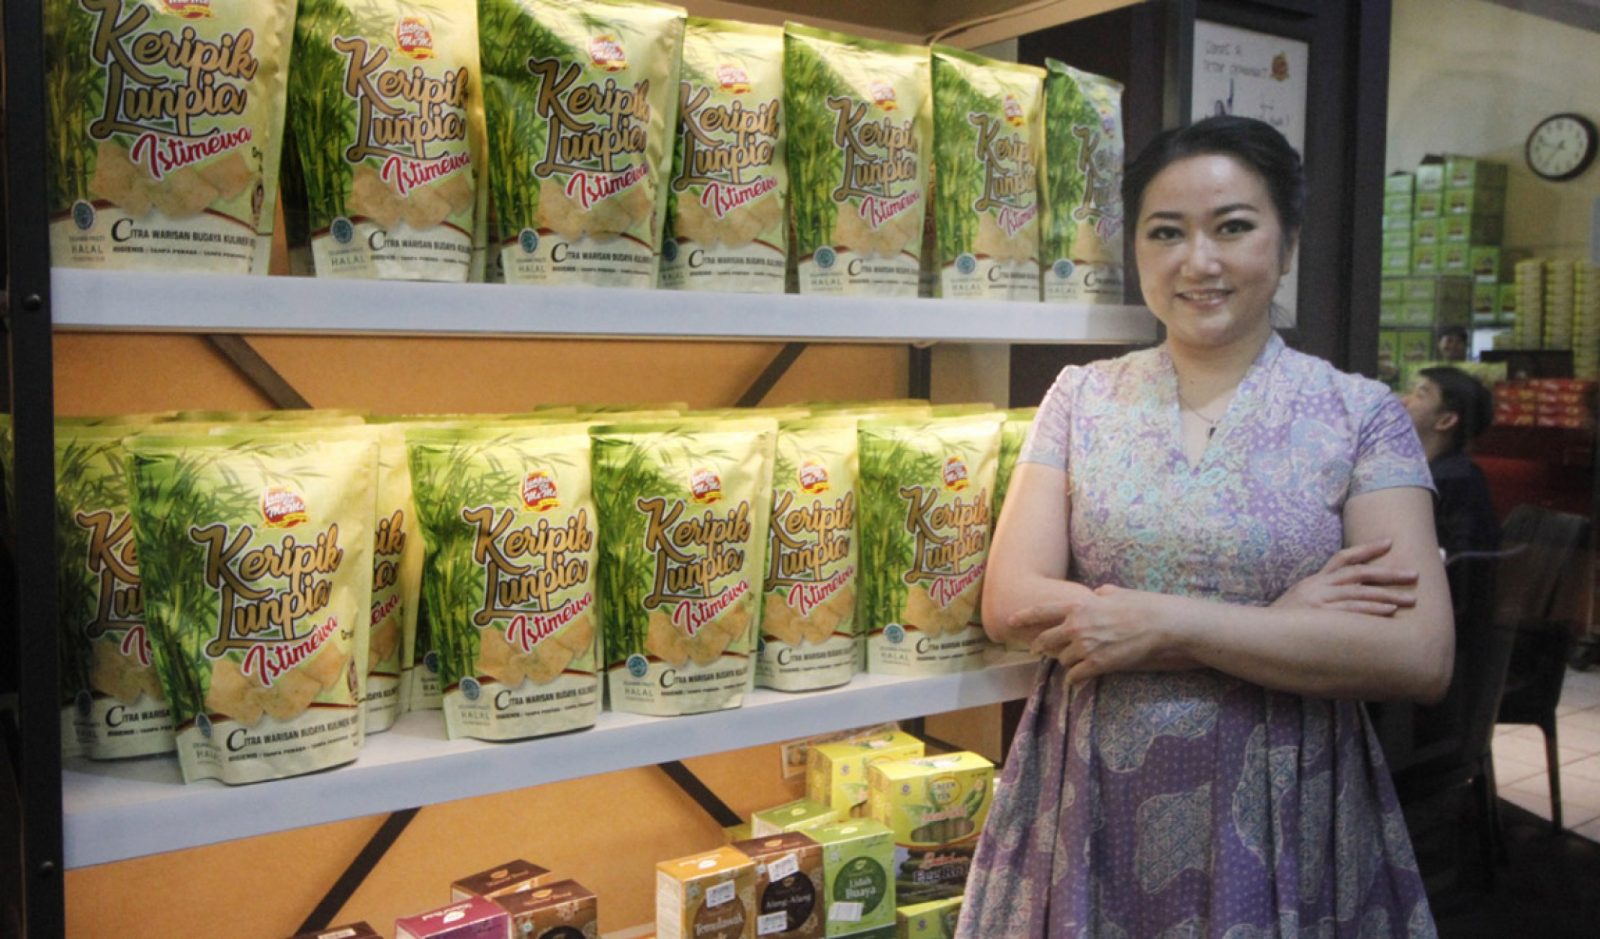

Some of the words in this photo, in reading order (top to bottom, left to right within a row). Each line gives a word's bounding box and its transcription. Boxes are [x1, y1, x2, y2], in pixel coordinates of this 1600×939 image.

[82, 0, 258, 88] Keripik
[89, 62, 247, 139] Lunpia
[346, 94, 466, 162] Lunpia
[131, 127, 252, 180] Istimewa
[382, 152, 471, 196] Istimewa
[672, 130, 775, 192] Lunpia
[566, 163, 648, 210] Istimewa
[702, 176, 778, 218] Istimewa
[462, 507, 593, 574] Keripik
[637, 498, 751, 560] Keripik
[900, 486, 988, 542] Keripik
[190, 523, 344, 597] Keripik
[643, 545, 744, 610] Lunpia
[763, 530, 850, 592] Lunpia
[903, 527, 985, 585] Lunpia
[206, 575, 333, 657] Lunpia
[473, 554, 588, 626] Lunpia
[673, 580, 749, 636] Istimewa
[788, 565, 854, 616] Istimewa
[242, 615, 338, 686] Istimewa
[506, 592, 592, 653] Istimewa
[226, 728, 262, 752] CITRA
[264, 731, 300, 745] WARISAN
